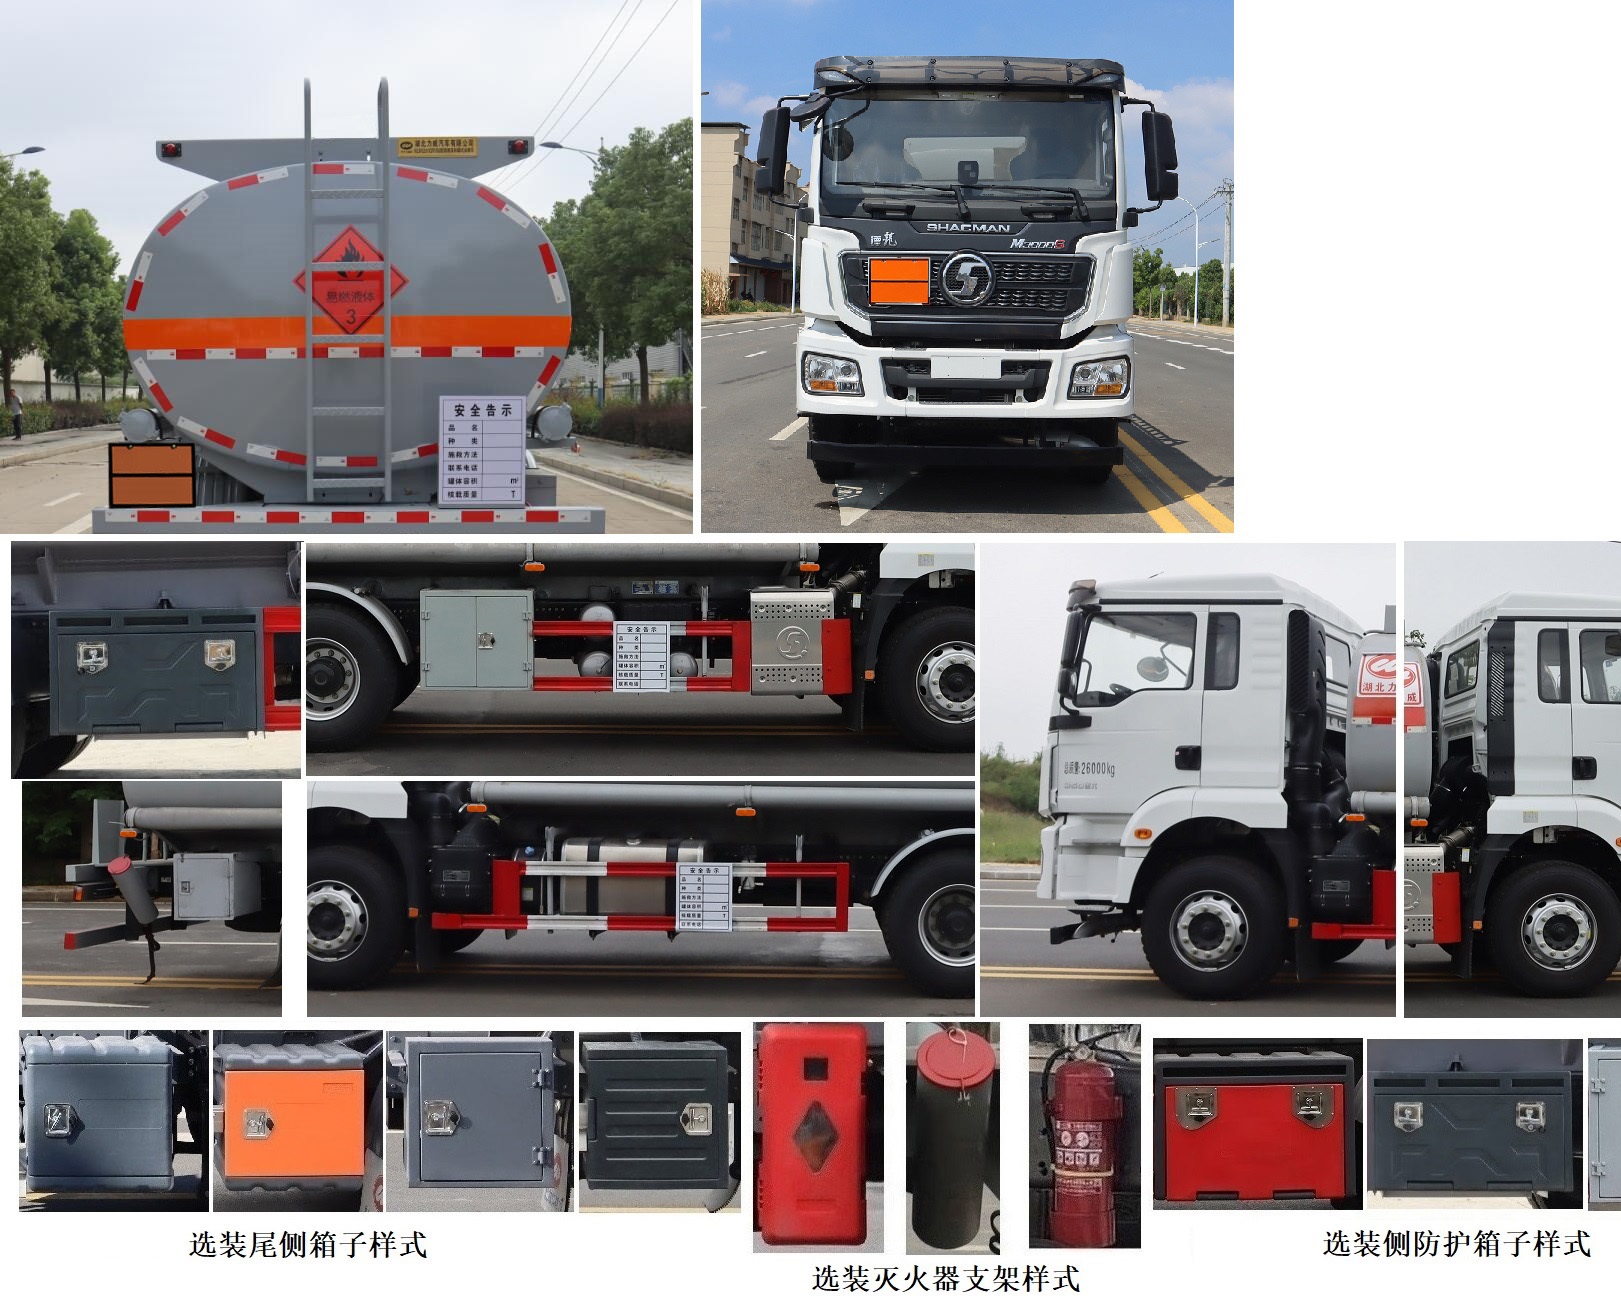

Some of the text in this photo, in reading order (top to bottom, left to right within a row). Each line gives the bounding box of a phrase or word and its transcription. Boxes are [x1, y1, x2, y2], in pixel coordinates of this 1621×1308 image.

[927, 223, 1011, 233] SHACMAN
[1010, 238, 1065, 249] M3000S
[326, 291, 374, 303] 易燃液体
[346, 308, 356, 324] 3
[454, 404, 512, 417] 安全告示
[1407, 692, 1417, 702] 威
